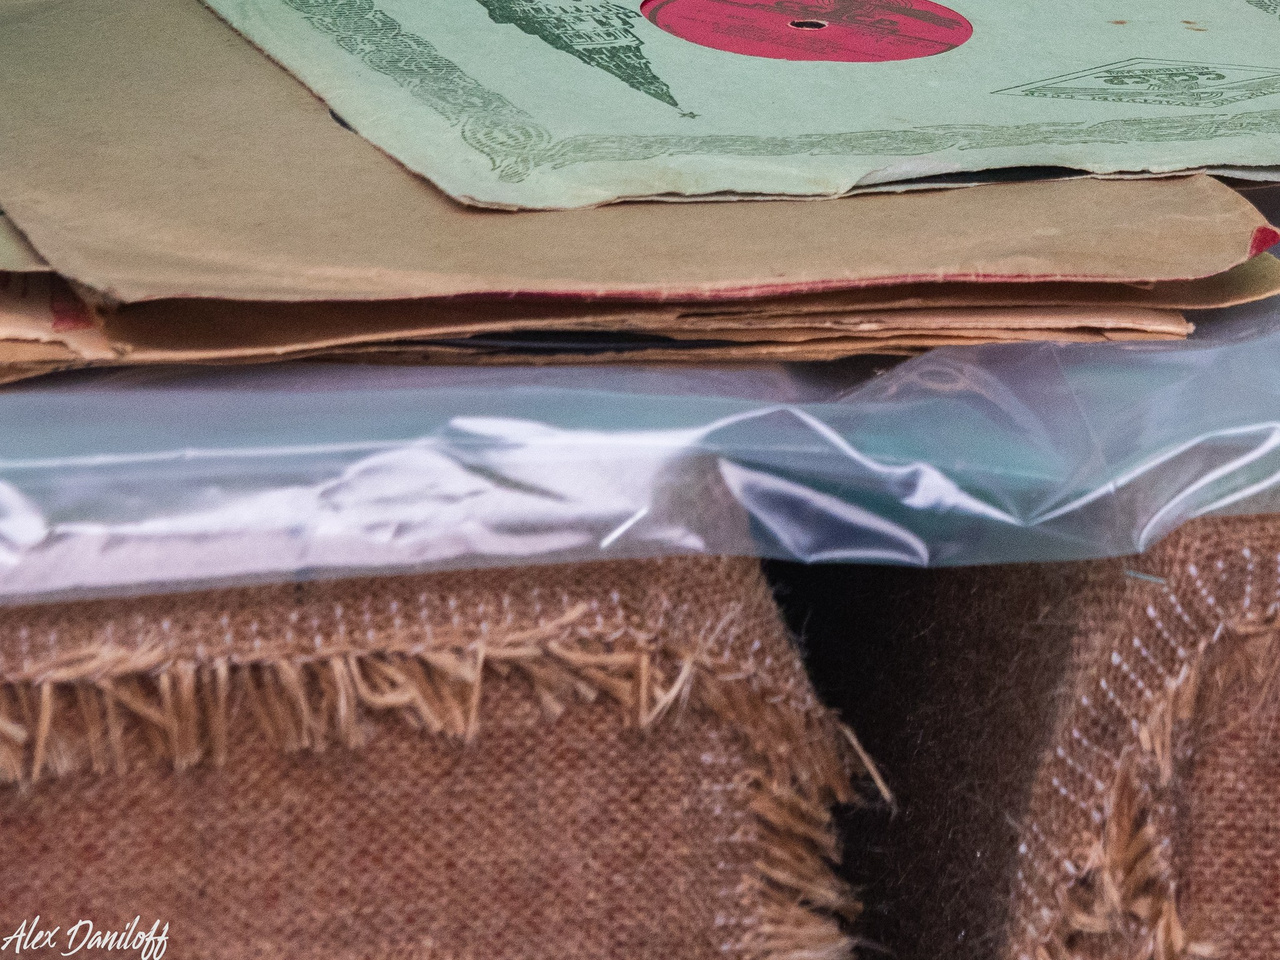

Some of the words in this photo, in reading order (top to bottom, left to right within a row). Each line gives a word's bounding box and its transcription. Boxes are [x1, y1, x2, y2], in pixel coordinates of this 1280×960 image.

[1102, 72, 1226, 86] СССР
[1024, 91, 1076, 100] СССР
[1090, 96, 1199, 107] КУЛЬТУРЫ
